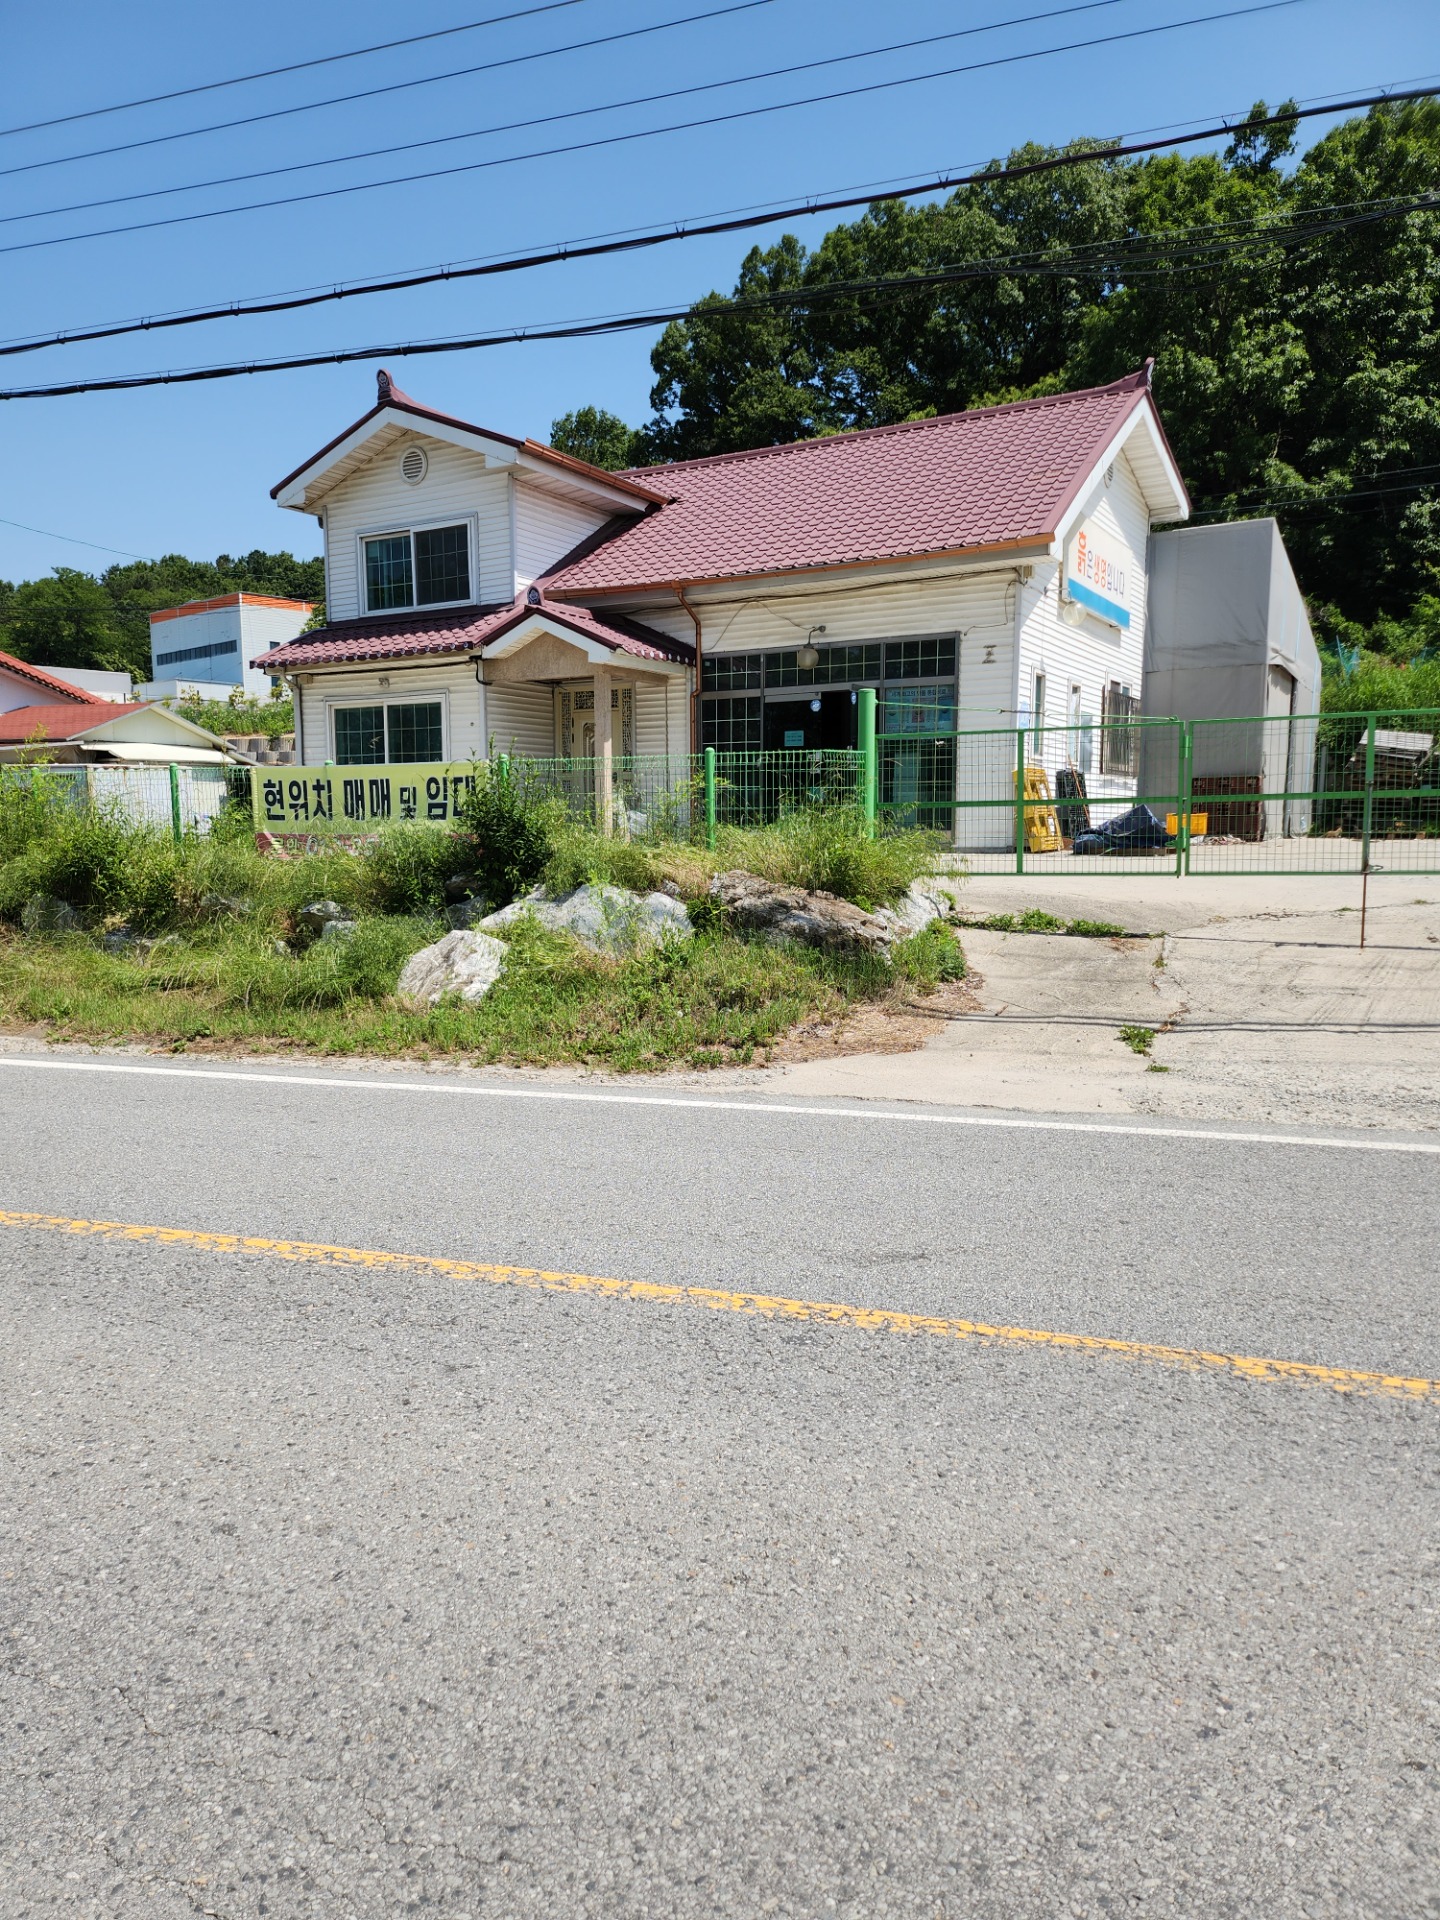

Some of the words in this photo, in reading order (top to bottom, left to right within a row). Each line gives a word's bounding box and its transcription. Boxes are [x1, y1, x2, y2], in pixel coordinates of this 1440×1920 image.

[263, 779, 333, 821] 현위치
[343, 778, 392, 821] 매매
[399, 786, 418, 821] 및
